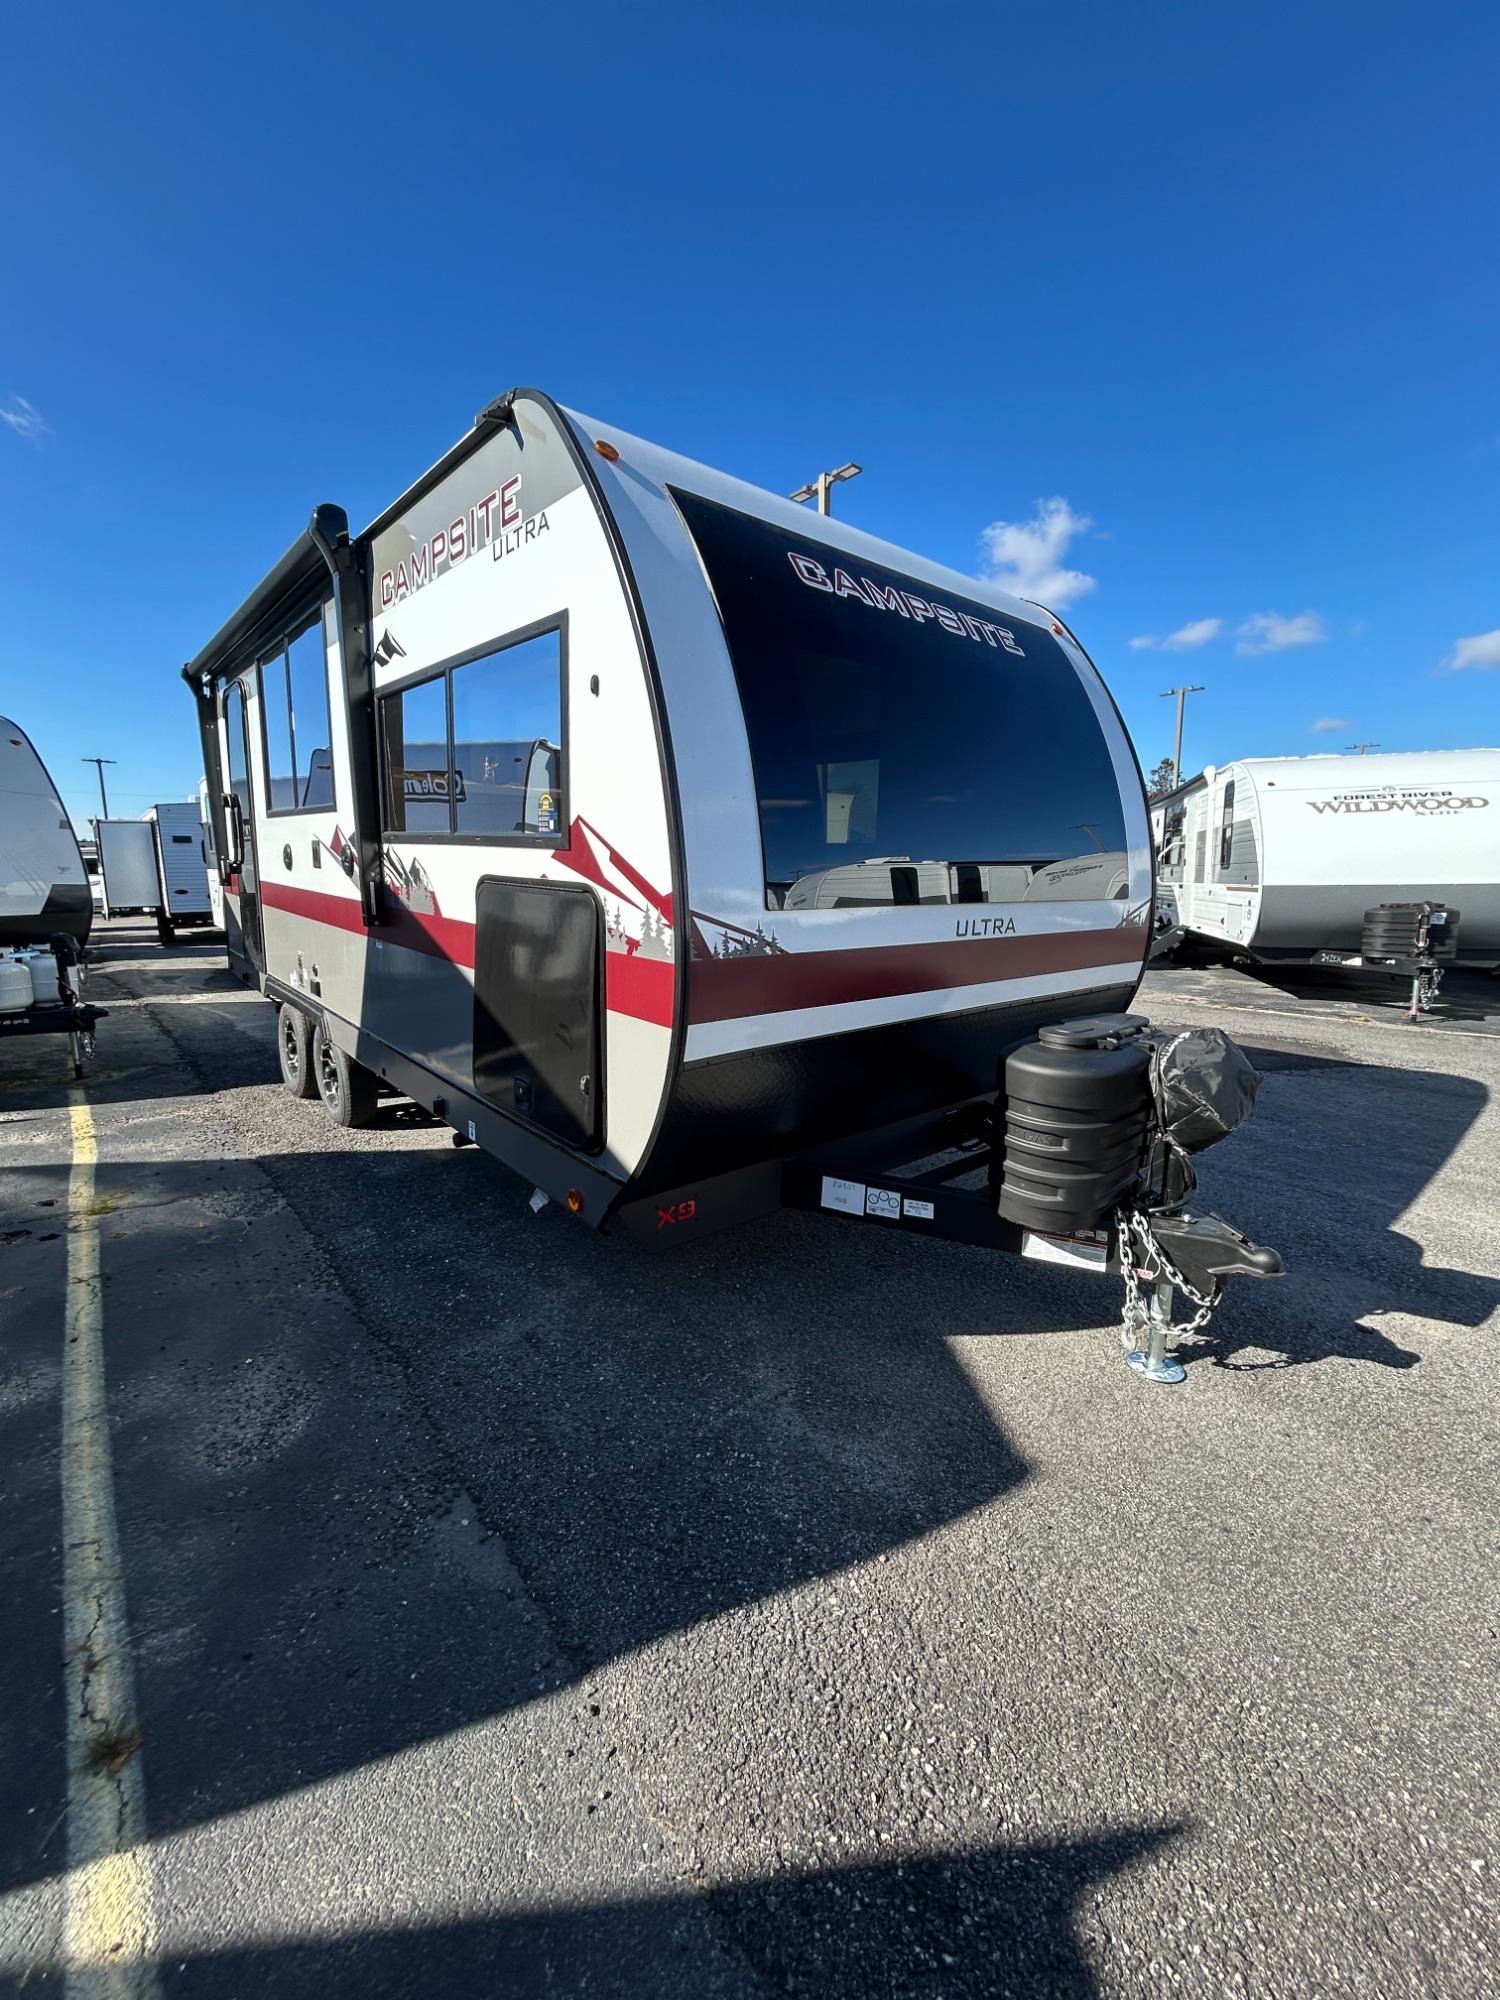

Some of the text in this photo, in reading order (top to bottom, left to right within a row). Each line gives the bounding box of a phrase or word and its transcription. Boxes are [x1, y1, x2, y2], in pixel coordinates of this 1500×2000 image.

[380, 473, 522, 611] CAMPSITE
[492, 511, 550, 562] ULTRA
[788, 552, 1026, 657] CAMPSITE
[1306, 797, 1490, 815] WILDWOOD
[1333, 793, 1398, 801] FOREST
[955, 917, 1016, 938] ULTRA
[1023, 1130, 1053, 1146] GAS
